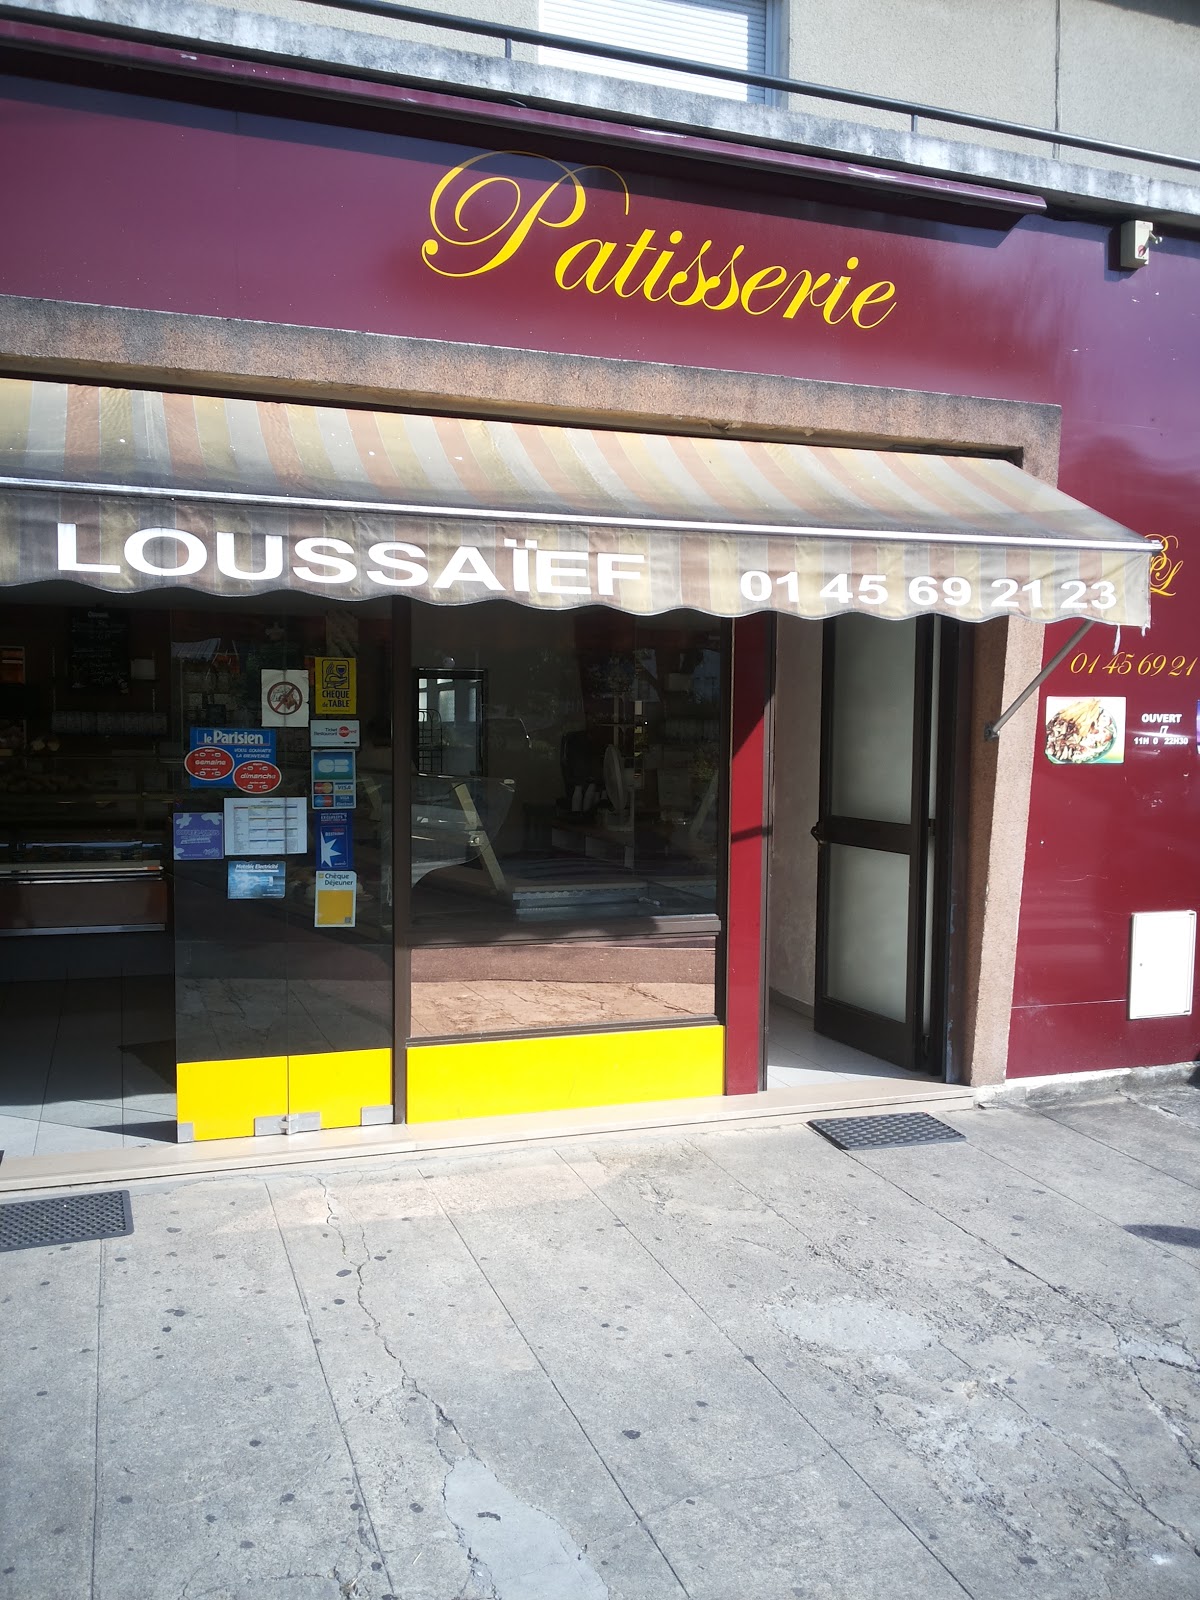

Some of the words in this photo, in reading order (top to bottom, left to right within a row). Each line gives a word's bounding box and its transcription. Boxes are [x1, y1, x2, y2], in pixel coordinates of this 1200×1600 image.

[421, 150, 898, 330] Patisserie
[57, 522, 645, 596] LOUSSAÏEF
[740, 570, 799, 602] 01
[819, 573, 889, 605] 45
[908, 576, 972, 607] 69
[990, 578, 1044, 608] 21
[1060, 579, 1118, 609] 23
[1070, 652, 1101, 674] 01
[1102, 651, 1135, 675] 45
[1137, 652, 1167, 677] 69
[1168, 654, 1199, 677] 21
[322, 690, 350, 699] CHEQUE
[328, 699, 350, 708] TABLE
[1141, 713, 1183, 723] OUVERT
[203, 732, 212, 744] le
[213, 729, 264, 745] Parisien
[1163, 737, 1189, 745] 22H30
[325, 879, 353, 887] Déjeuner
